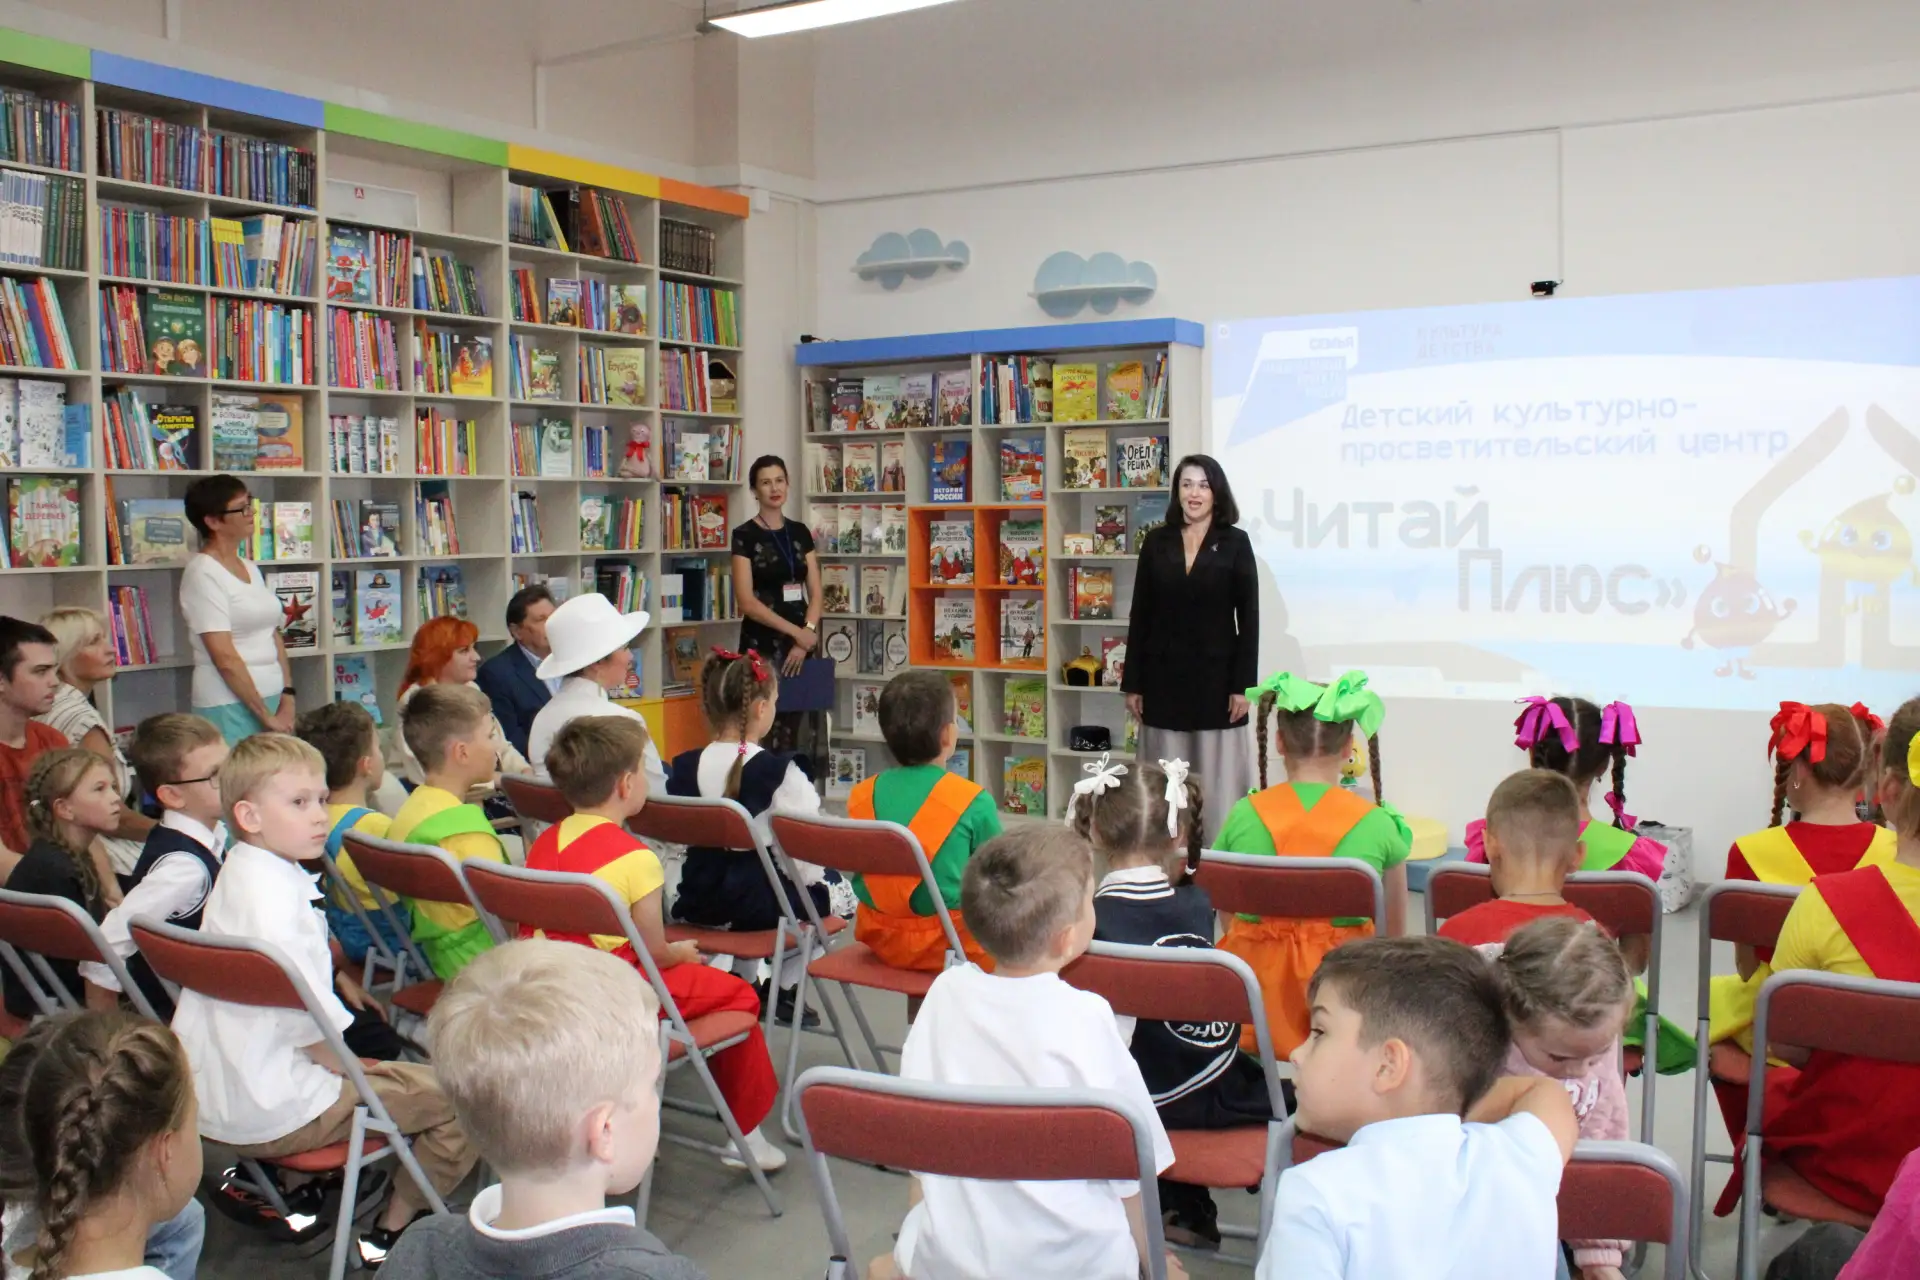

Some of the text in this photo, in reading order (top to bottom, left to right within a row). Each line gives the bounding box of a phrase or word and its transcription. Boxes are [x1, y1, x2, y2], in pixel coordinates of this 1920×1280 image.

[1309, 336, 1354, 350] СЕМЬЯ
[219, 411, 251, 419] БОЛЬШАЯ
[1341, 397, 1698, 431] Детский культурно-
[222, 428, 249, 436] МОСТОВ
[1127, 443, 1151, 460] ОРЁЛ
[1341, 428, 1789, 468] просветительский центр
[1127, 460, 1152, 471] РЕШКА
[1458, 548, 1688, 616] Плюс»
